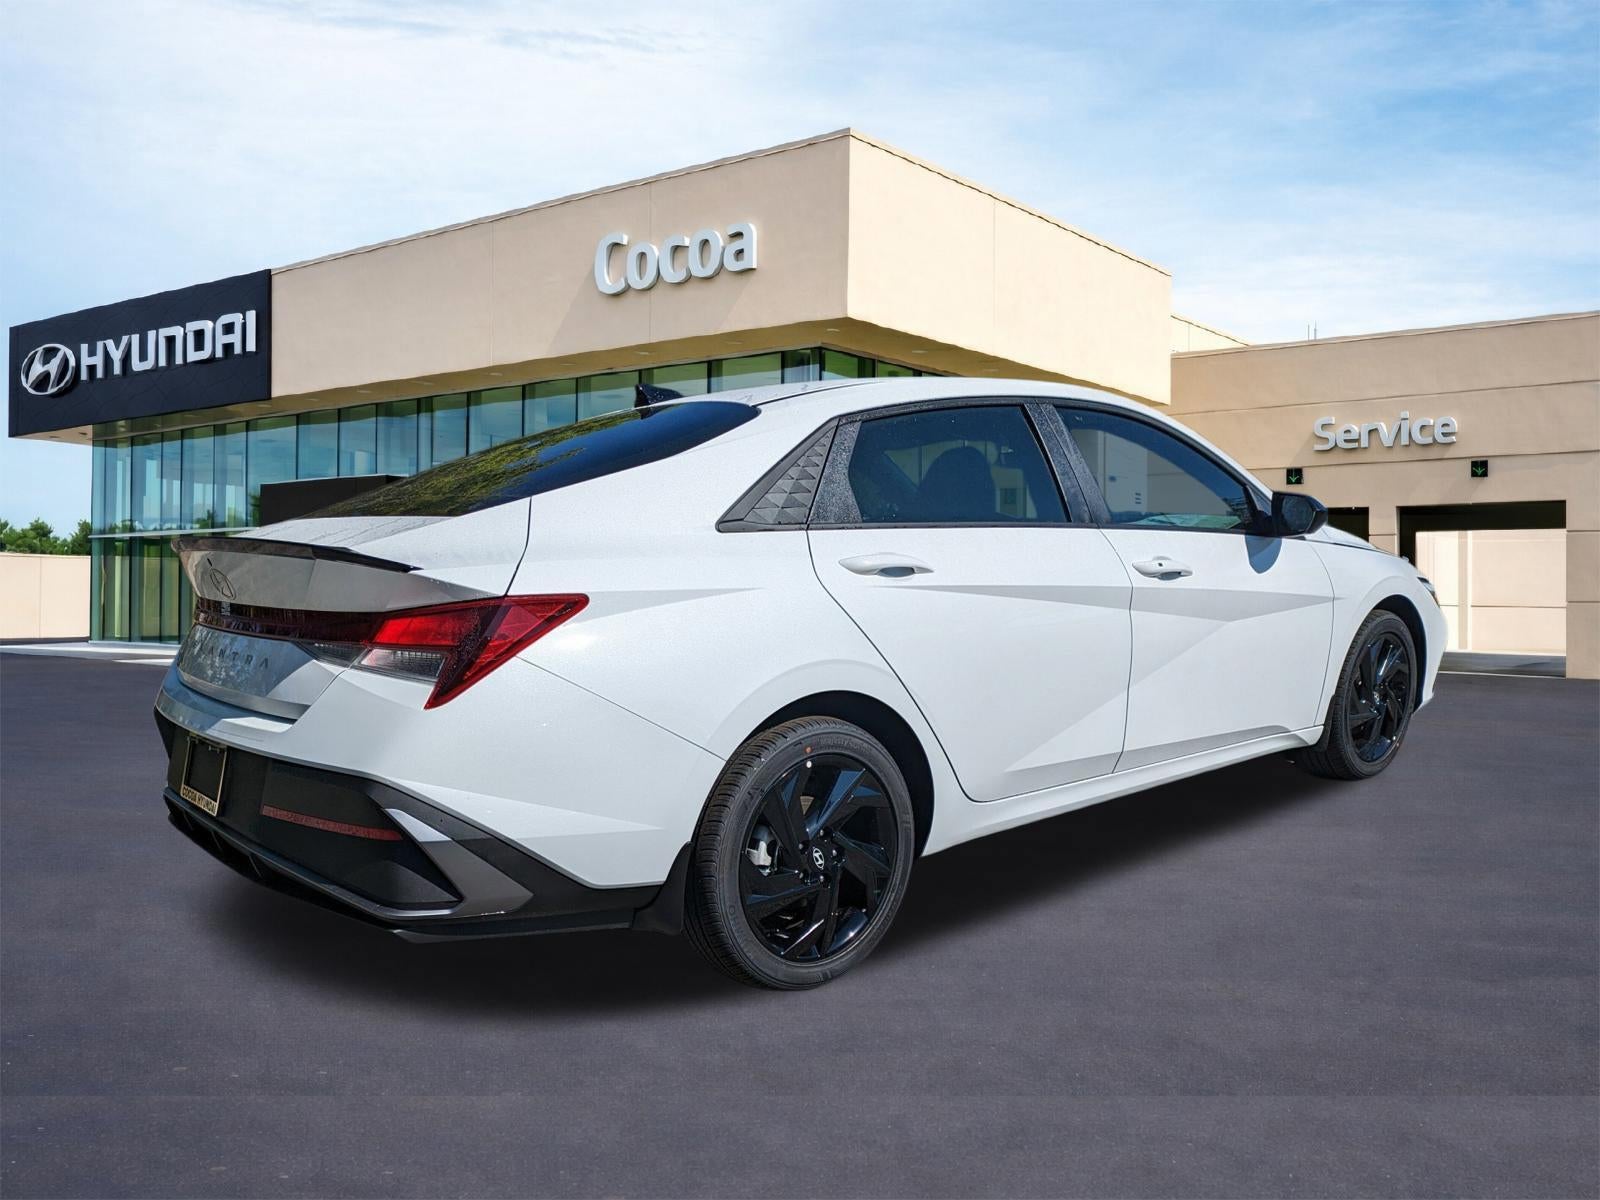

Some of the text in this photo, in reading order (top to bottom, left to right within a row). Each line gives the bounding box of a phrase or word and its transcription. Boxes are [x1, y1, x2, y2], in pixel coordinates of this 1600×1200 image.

[594, 223, 758, 295] Cocoa
[80, 310, 257, 381] HYUNDAI
[1313, 410, 1458, 451] Service
